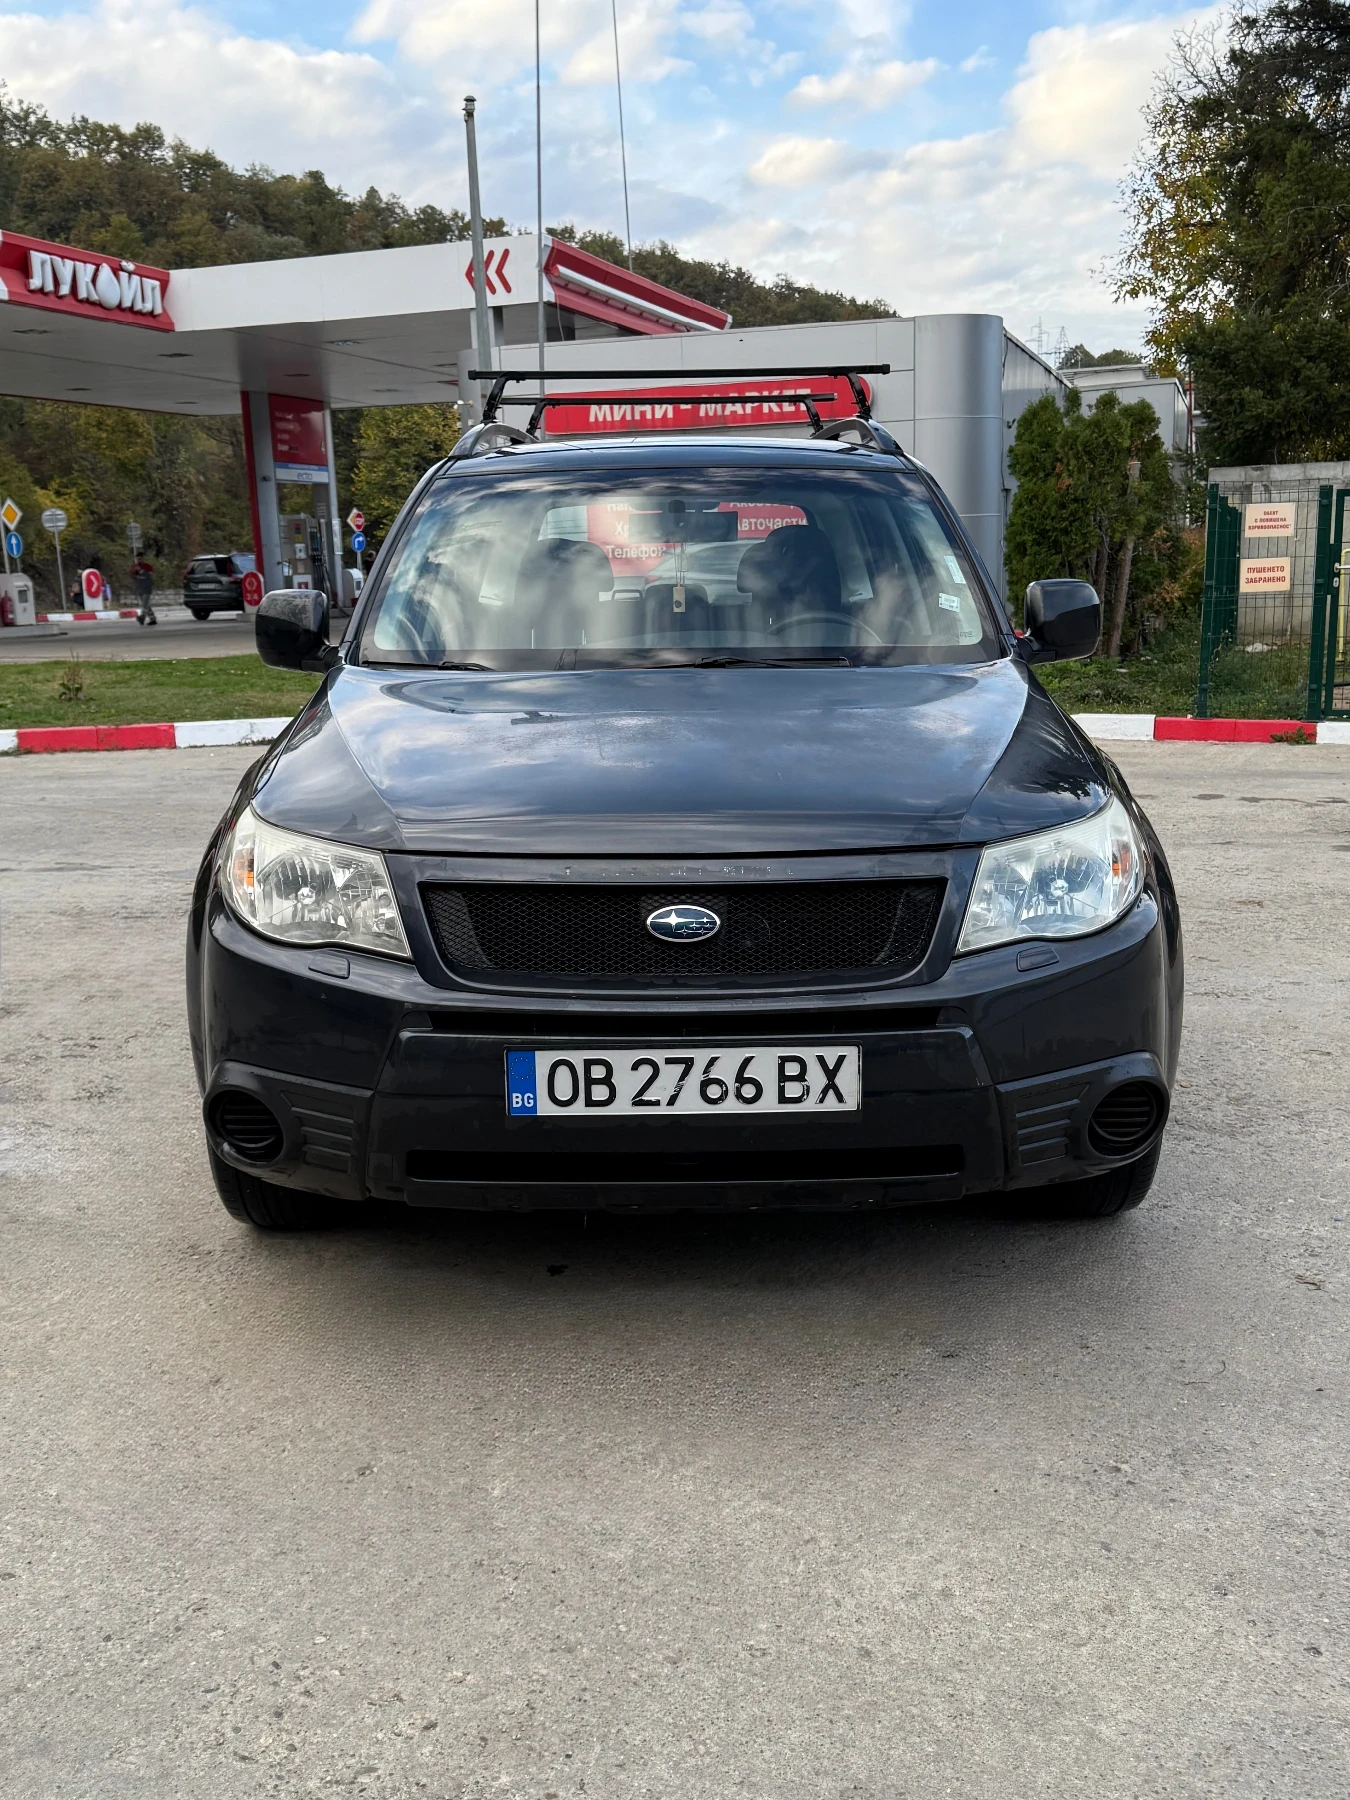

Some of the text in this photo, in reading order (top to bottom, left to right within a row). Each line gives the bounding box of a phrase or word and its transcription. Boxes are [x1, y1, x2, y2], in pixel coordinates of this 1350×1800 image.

[589, 402, 673, 422] МИНИ
[700, 388, 811, 417] МАРКЕТ
[1247, 566, 1285, 574] ПУШЕНЕТО
[1244, 576, 1286, 584] ЗАБРАНЕНО
[547, 1054, 847, 1107] OB 2766 BX
[512, 1092, 534, 1107] BG
